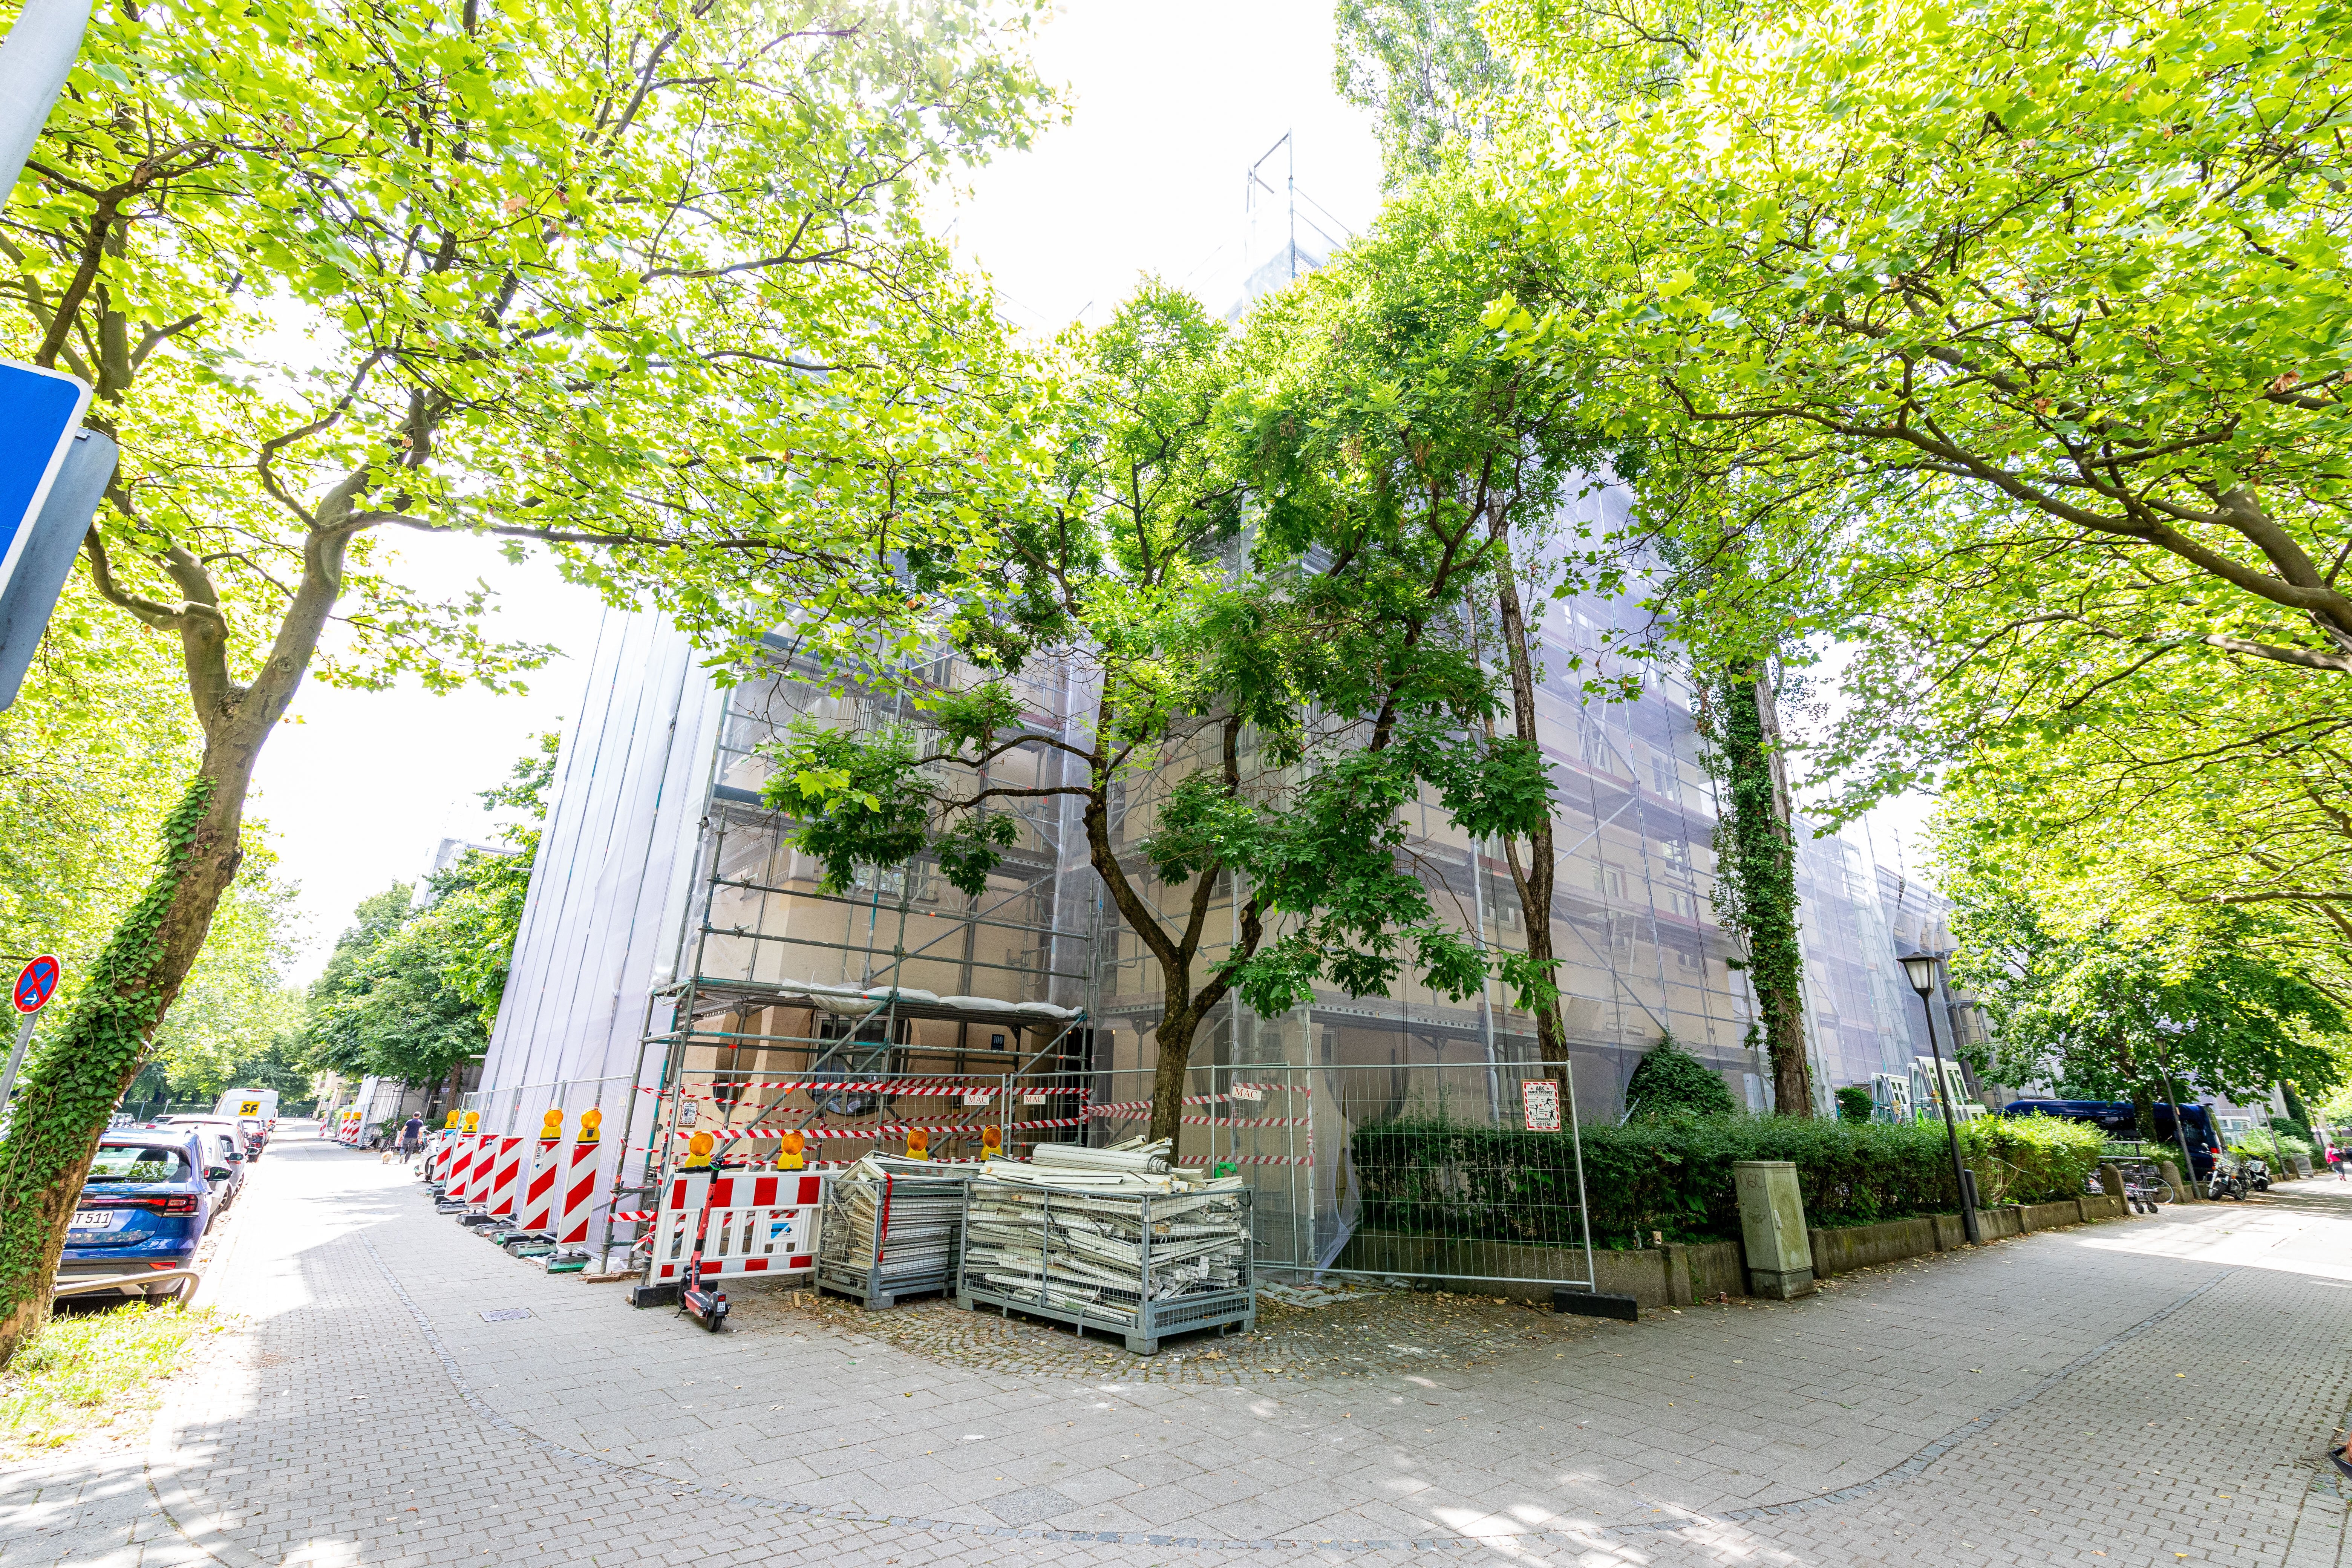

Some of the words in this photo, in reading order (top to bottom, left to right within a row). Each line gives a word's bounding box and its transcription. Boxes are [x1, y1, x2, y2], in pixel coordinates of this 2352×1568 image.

[994, 1036, 1003, 1044] 100
[1235, 1087, 1257, 1099] MAC
[241, 1104, 258, 1113] SF
[85, 1213, 110, 1223] 511
